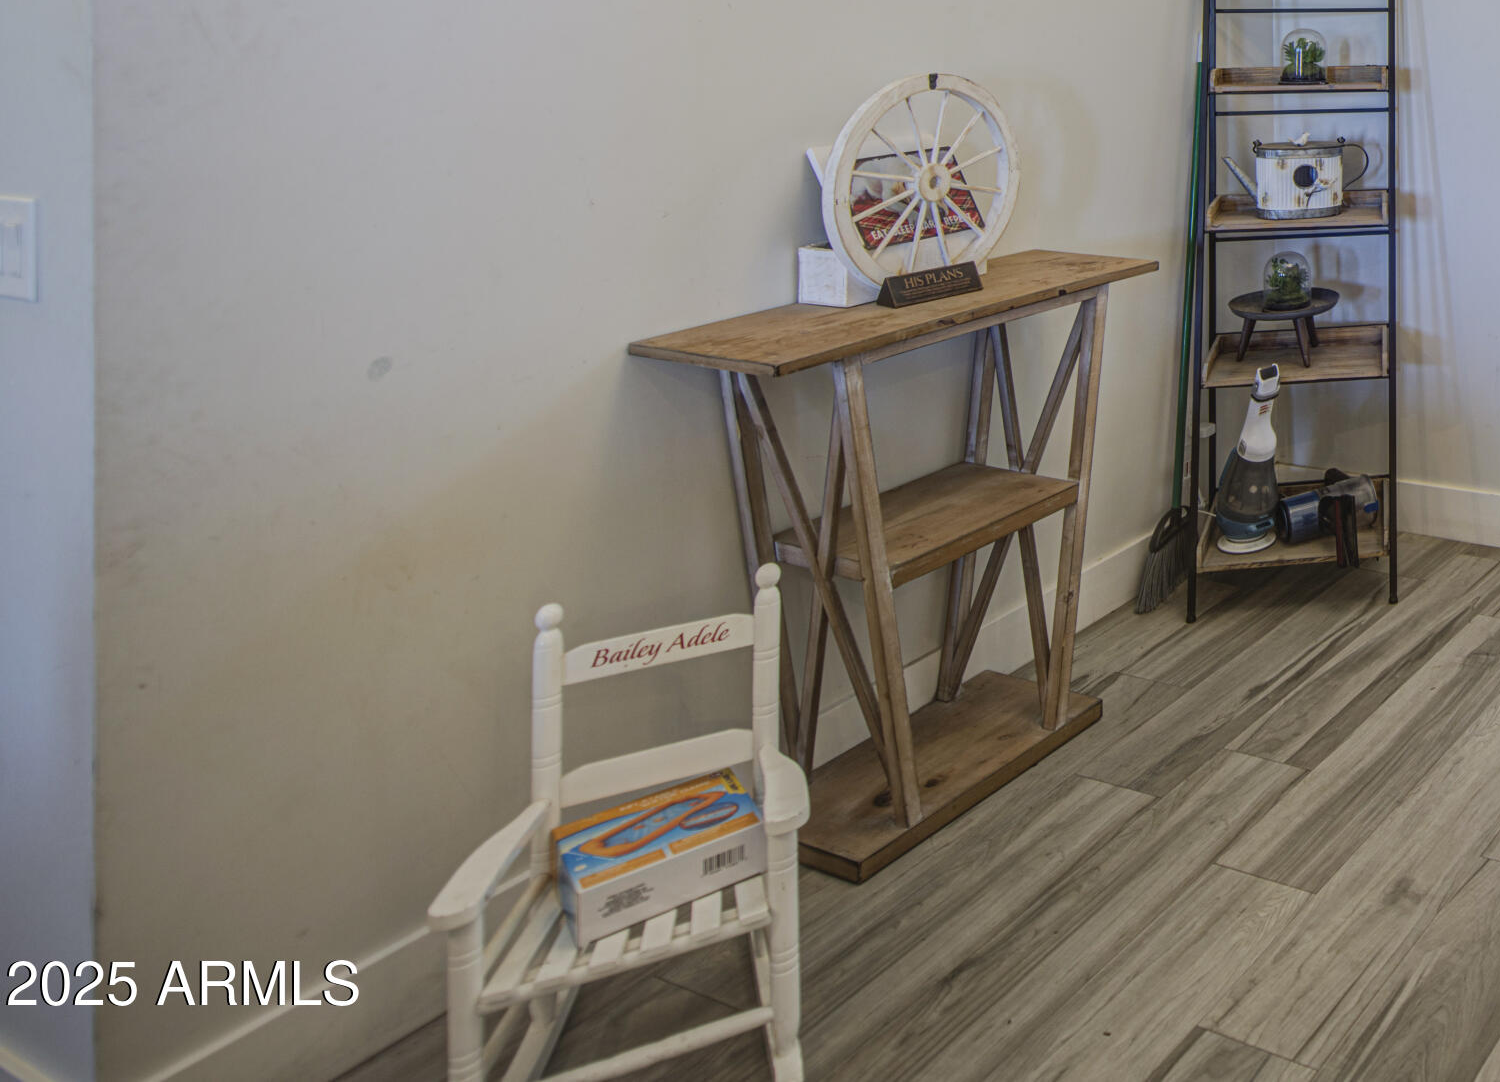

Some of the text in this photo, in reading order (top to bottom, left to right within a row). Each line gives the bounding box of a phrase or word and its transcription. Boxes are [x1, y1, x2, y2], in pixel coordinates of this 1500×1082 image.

[904, 275, 925, 289] HIS
[925, 268, 964, 284] PLANS
[591, 621, 730, 668] Bailey Adele
